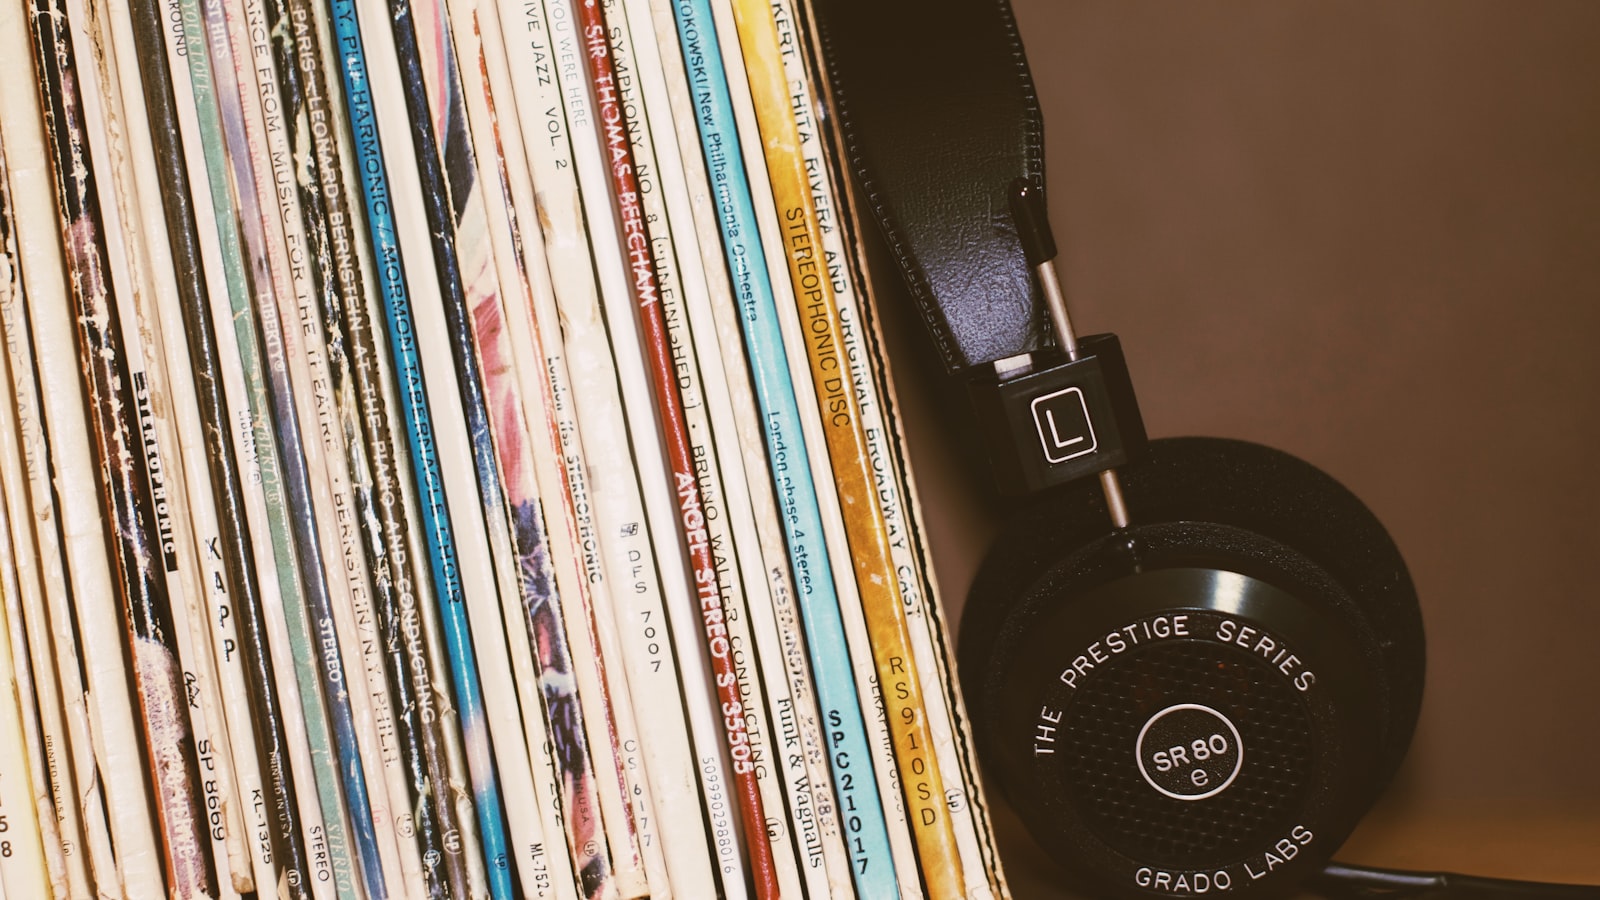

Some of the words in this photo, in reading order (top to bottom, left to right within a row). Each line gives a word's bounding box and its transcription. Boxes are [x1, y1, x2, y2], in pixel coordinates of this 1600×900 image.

[210, 21, 230, 59] HITS
[584, 24, 607, 59] SIR
[530, 39, 551, 86] JAZZ
[543, 107, 563, 152] VOL.
[554, 158, 567, 170] 2
[557, 38, 577, 81] WERE
[567, 87, 587, 128] HERE
[306, 95, 341, 199] LEONARD
[593, 71, 631, 179] THOMAS
[257, 67, 281, 133] FROM
[285, 234, 306, 280] FOR
[296, 292, 316, 336] THE
[706, 132, 742, 237] Philharmonia
[730, 243, 759, 323] Orchestra
[327, 211, 364, 331] BERNSTEIN
[617, 191, 657, 308] BEECHAM
[341, 35, 388, 216] PHILHARMONIC
[380, 245, 414, 353] MORMON
[402, 361, 445, 517] TABERNACLE
[433, 526, 461, 605] CHOIR
[784, 206, 838, 371] STEREOPHONIC
[823, 377, 850, 428] DISC
[352, 343, 371, 372] AT
[804, 157, 833, 235] RIVERA
[824, 248, 846, 295] AND
[838, 305, 873, 415] ORIGINAL
[865, 427, 905, 551] BROADWAY
[897, 564, 921, 619] CAST
[359, 383, 382, 430] THE
[607, 26, 643, 150] SYMPHONY
[645, 213, 658, 224] 8
[691, 445, 718, 521] BRUNO
[709, 534, 738, 622] WALTER
[728, 635, 769, 780] CONDUCTING
[765, 411, 791, 471] London
[1045, 409, 1084, 448] L
[136, 388, 174, 553] STEREOPHONIC
[369, 440, 396, 507] PIANO
[777, 476, 800, 525] phase
[383, 518, 406, 566] AND
[565, 454, 602, 584] STEREOPHONIC
[673, 468, 709, 556] ANGEL
[790, 529, 804, 539] 4
[793, 543, 815, 595] stereo
[628, 550, 647, 593] DFS
[641, 611, 661, 673] 7007
[693, 565, 730, 659] STEREO
[317, 617, 343, 683] STEREO
[394, 577, 437, 724] CONDUCTING
[714, 671, 736, 687] S
[1034, 705, 1063, 758] THE
[1060, 615, 1189, 689] PRESTIGE
[1216, 620, 1316, 692] SERIES
[197, 739, 214, 772] SP
[720, 699, 754, 775] 35505
[776, 696, 800, 748] Funk
[889, 656, 936, 826] RS910SD
[789, 753, 804, 769] &
[826, 709, 871, 875] SPC21017
[1190, 768, 1209, 786] e
[202, 779, 227, 842] 8669
[249, 789, 274, 864] KL-1325
[787, 774, 825, 869] Wagnalls
[308, 825, 330, 882] STEREO
[323, 820, 352, 893] STEREO
[1135, 867, 1231, 894] GRADO
[1244, 825, 1314, 880] LABS
